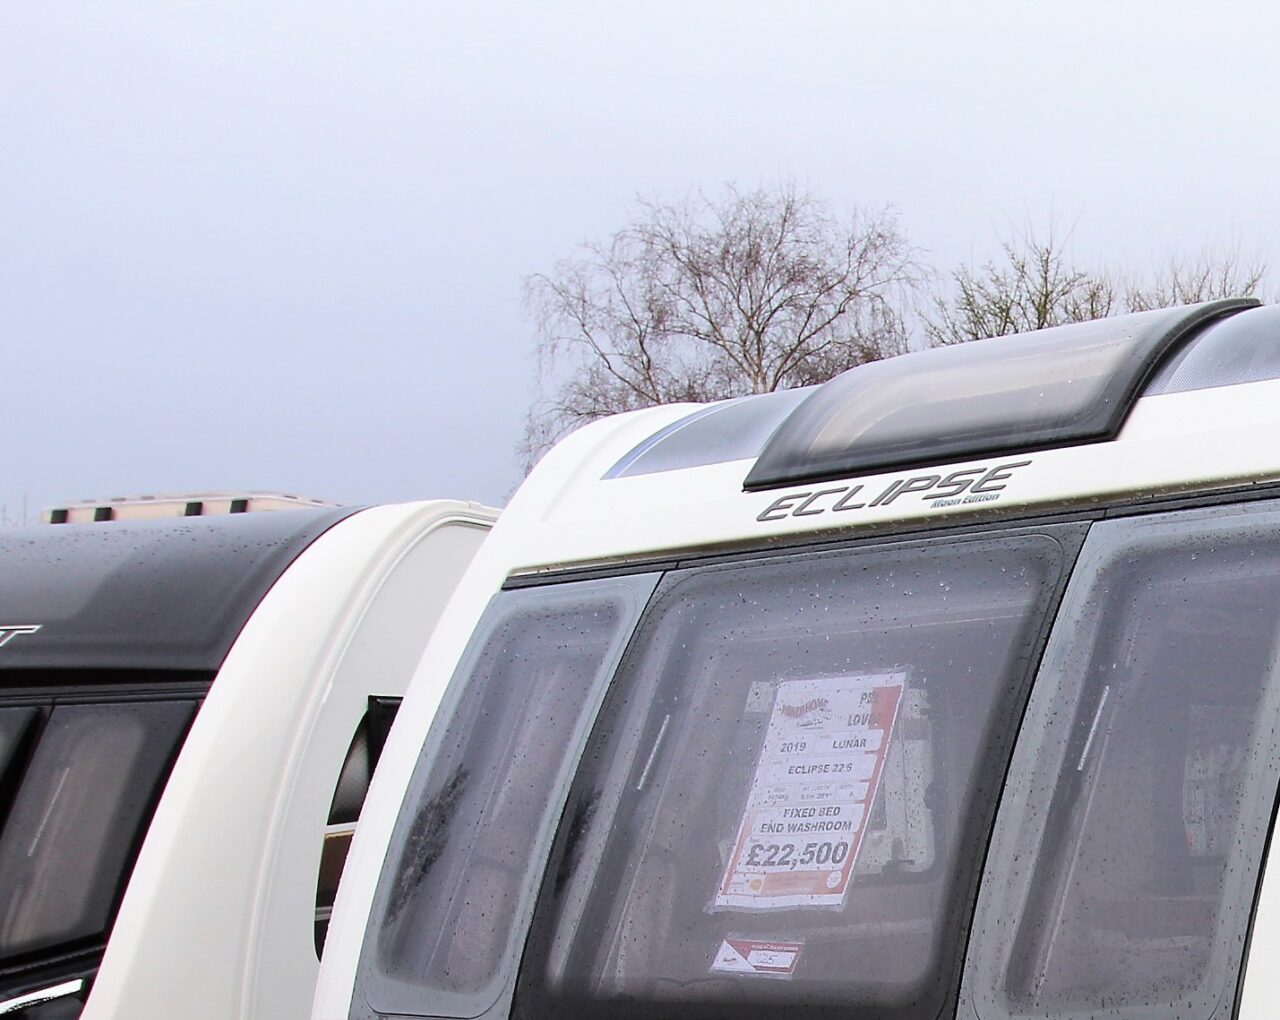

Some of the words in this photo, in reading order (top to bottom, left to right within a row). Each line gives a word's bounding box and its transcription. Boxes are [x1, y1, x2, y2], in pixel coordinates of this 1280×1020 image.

[756, 460, 1032, 522] ECLIPSE
[931, 497, 962, 509] Moon
[962, 493, 1001, 505] Edition
[780, 742, 807, 753] 2019
[832, 738, 867, 749] LUNAR
[788, 764, 831, 775] ECLIPSE
[783, 807, 816, 818] FIXED
[818, 806, 841, 817] BED
[760, 823, 785, 834] END
[787, 821, 852, 833] WASHROOM
[746, 841, 849, 870] £22,500
